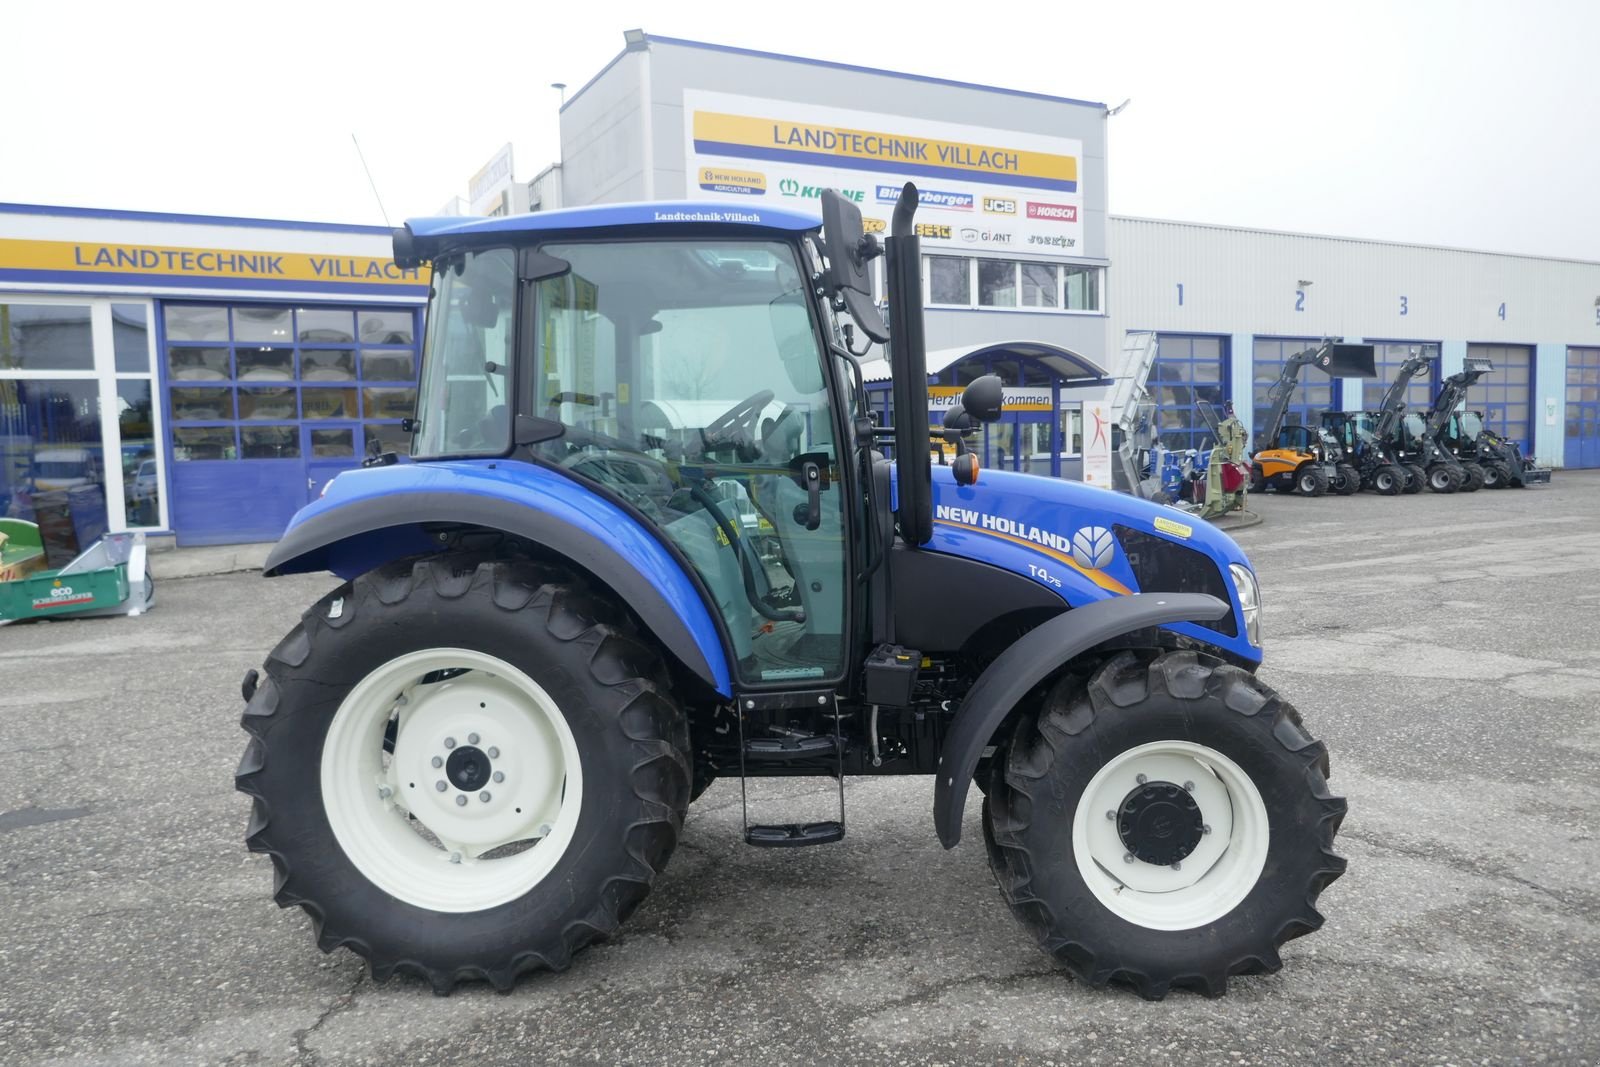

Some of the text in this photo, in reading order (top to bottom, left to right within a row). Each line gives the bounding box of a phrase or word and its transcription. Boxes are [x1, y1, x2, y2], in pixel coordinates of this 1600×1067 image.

[773, 125, 1019, 171] LANDTECHNIK VILLACH
[731, 175, 761, 184] HOLLAND
[714, 185, 751, 193] AGRICULTURE
[801, 186, 865, 202] KRNE
[880, 187, 972, 206] Binrberger
[985, 200, 1015, 213] JCB
[1037, 207, 1074, 219] HORSCH
[655, 212, 761, 222] Landtechnik-Villach
[75, 246, 419, 280] LANDTECHNIK VILLACH
[1176, 283, 1184, 306] 1
[1295, 290, 1305, 311] 2
[1400, 296, 1408, 315] 3
[1497, 303, 1506, 321] 4
[928, 392, 961, 406] Herzli
[937, 504, 1071, 553] NEW HOLLAND
[51, 587, 72, 597] eco
